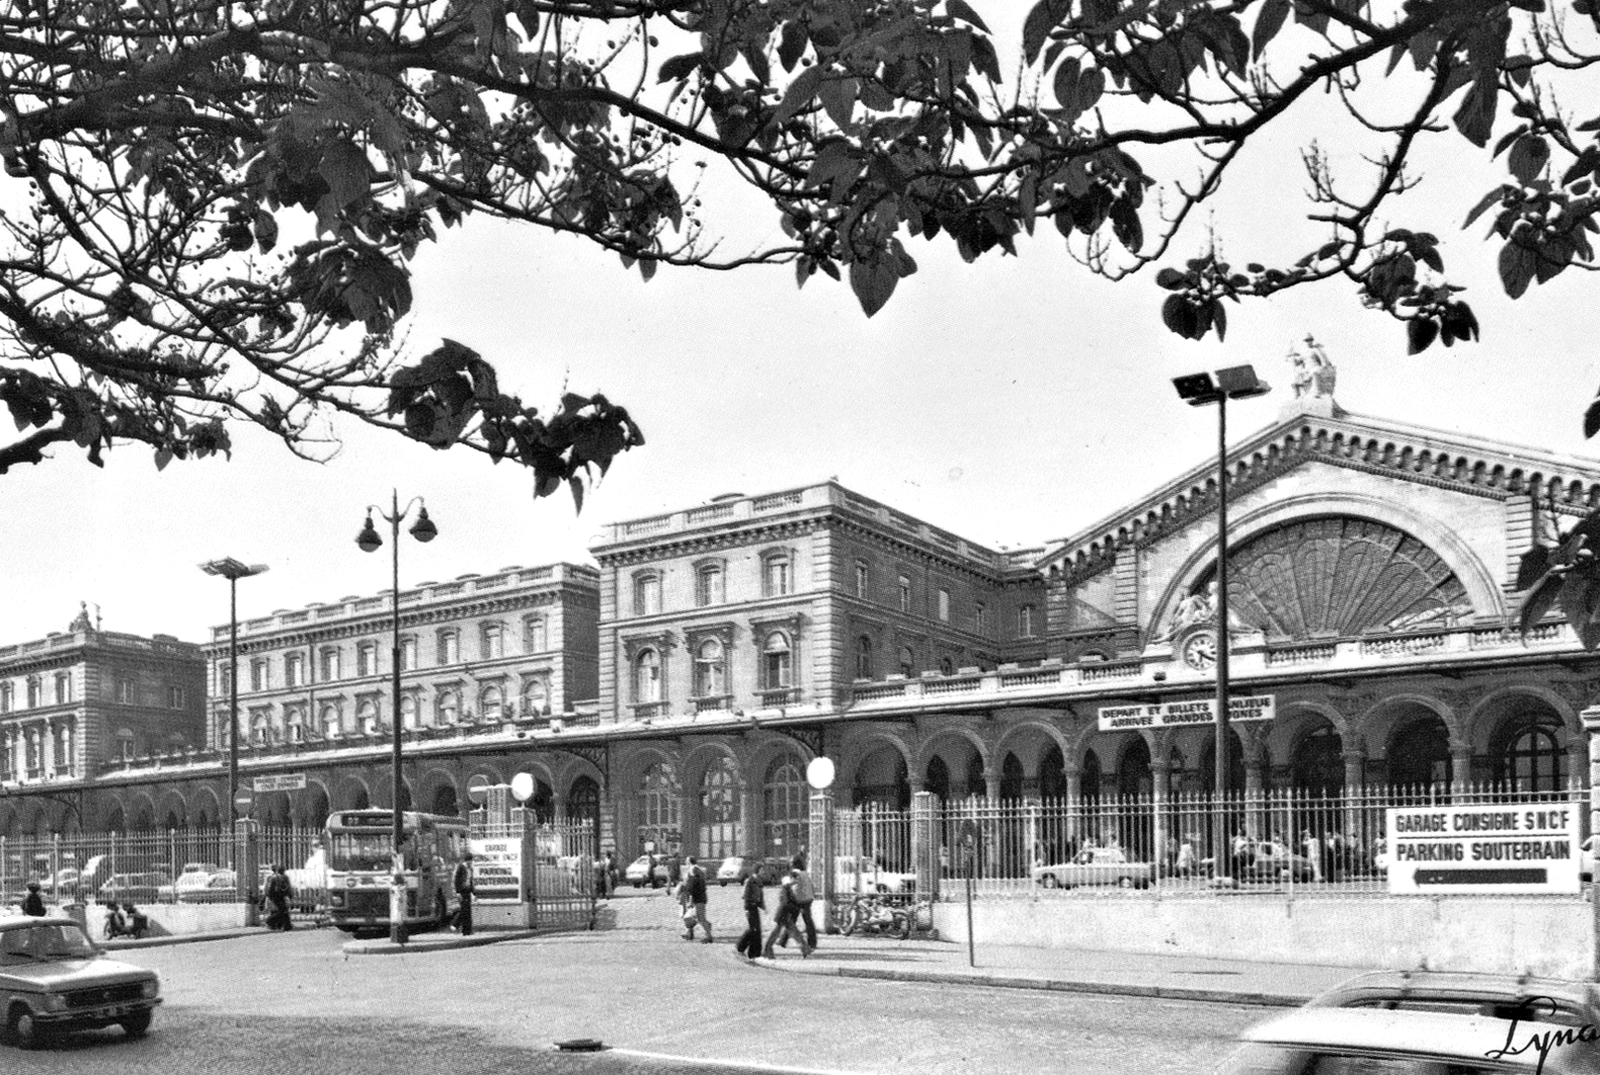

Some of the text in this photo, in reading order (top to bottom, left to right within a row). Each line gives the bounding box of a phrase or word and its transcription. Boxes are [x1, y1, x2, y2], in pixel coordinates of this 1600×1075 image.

[1101, 706, 1142, 719] DEPART
[1147, 706, 1161, 716] ET
[1167, 702, 1210, 715] BILLETS
[1162, 711, 1214, 724] GRANDES
[1396, 810, 1570, 832] GARAGE CONSIGNE SNCF
[1396, 840, 1571, 861] PARKING SOUTERRAIN
[478, 867, 512, 876] PARKING
